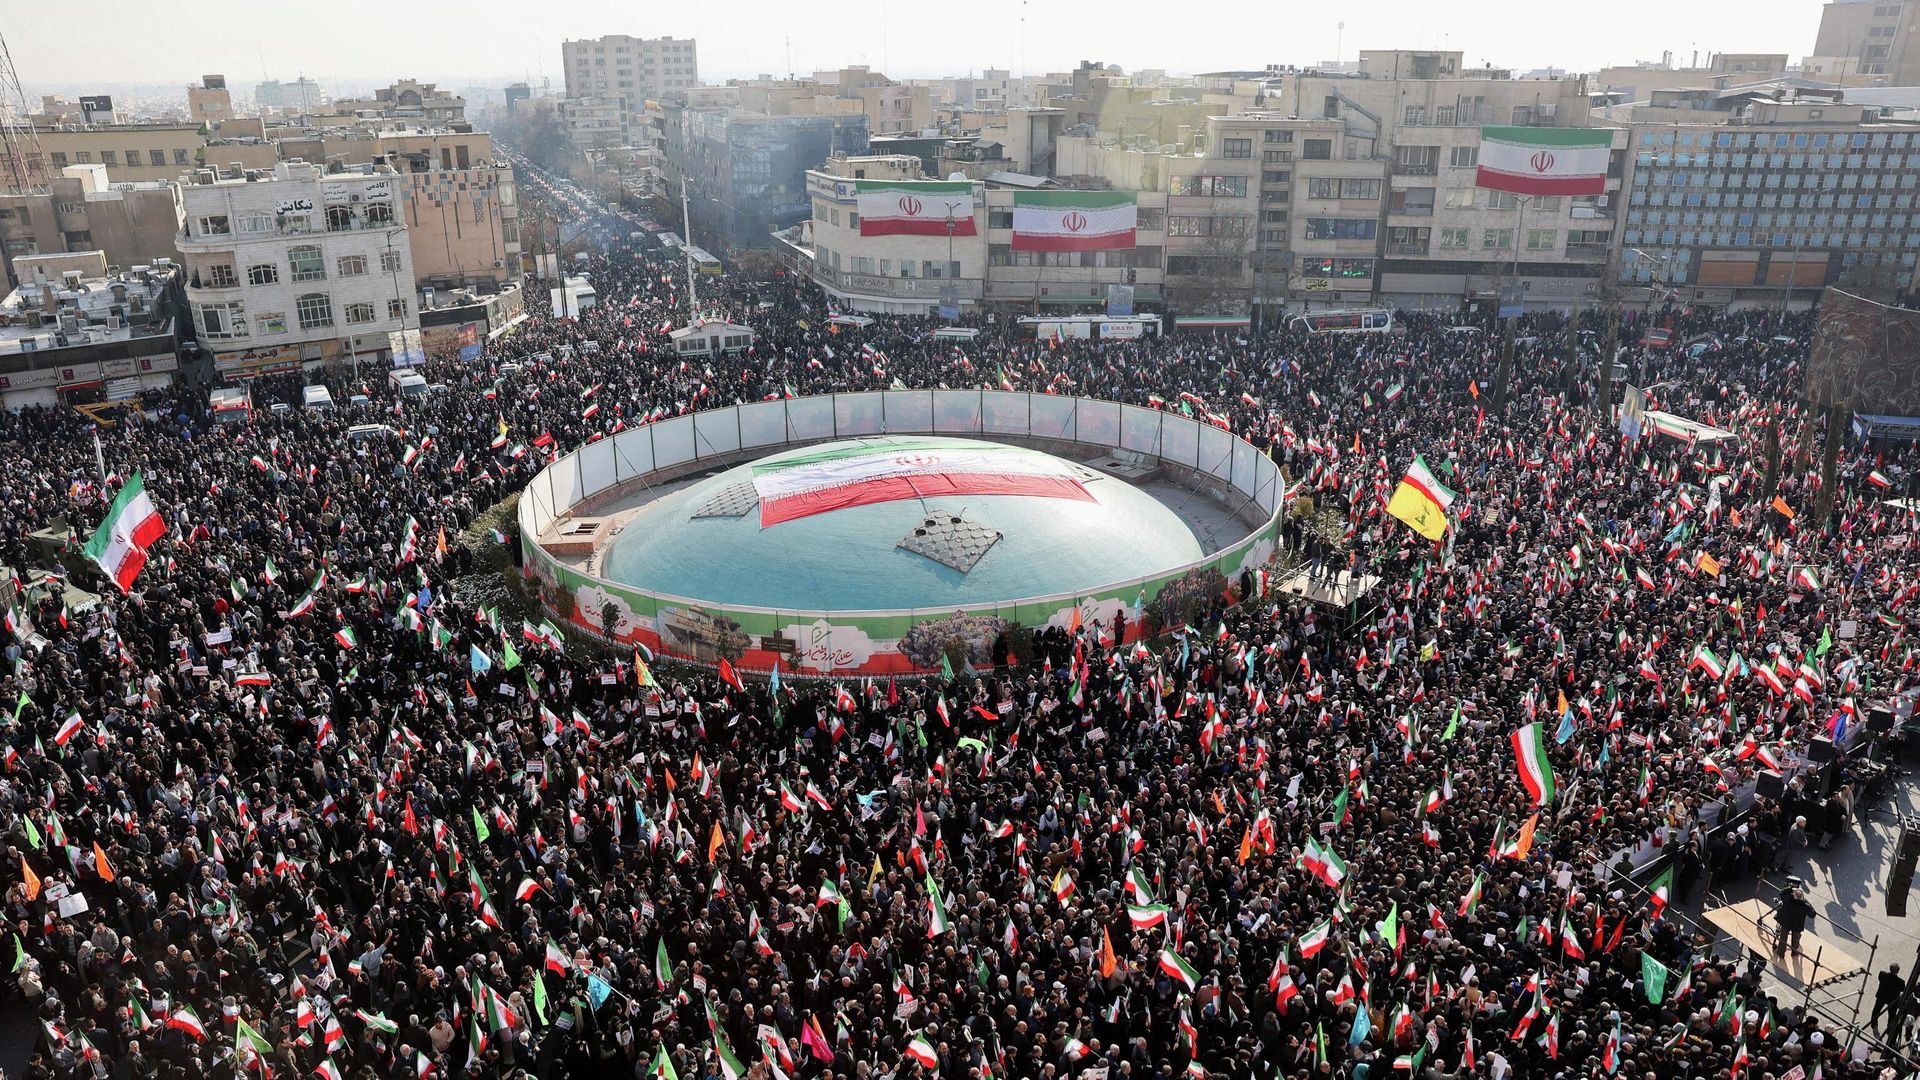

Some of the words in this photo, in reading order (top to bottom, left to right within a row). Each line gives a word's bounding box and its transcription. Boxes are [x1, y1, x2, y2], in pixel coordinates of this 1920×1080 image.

[366, 181, 389, 190] آکادمی
[1306, 280, 1328, 290] عکاسی
[811, 627, 832, 644] مردم
[835, 649, 854, 665] علاج
